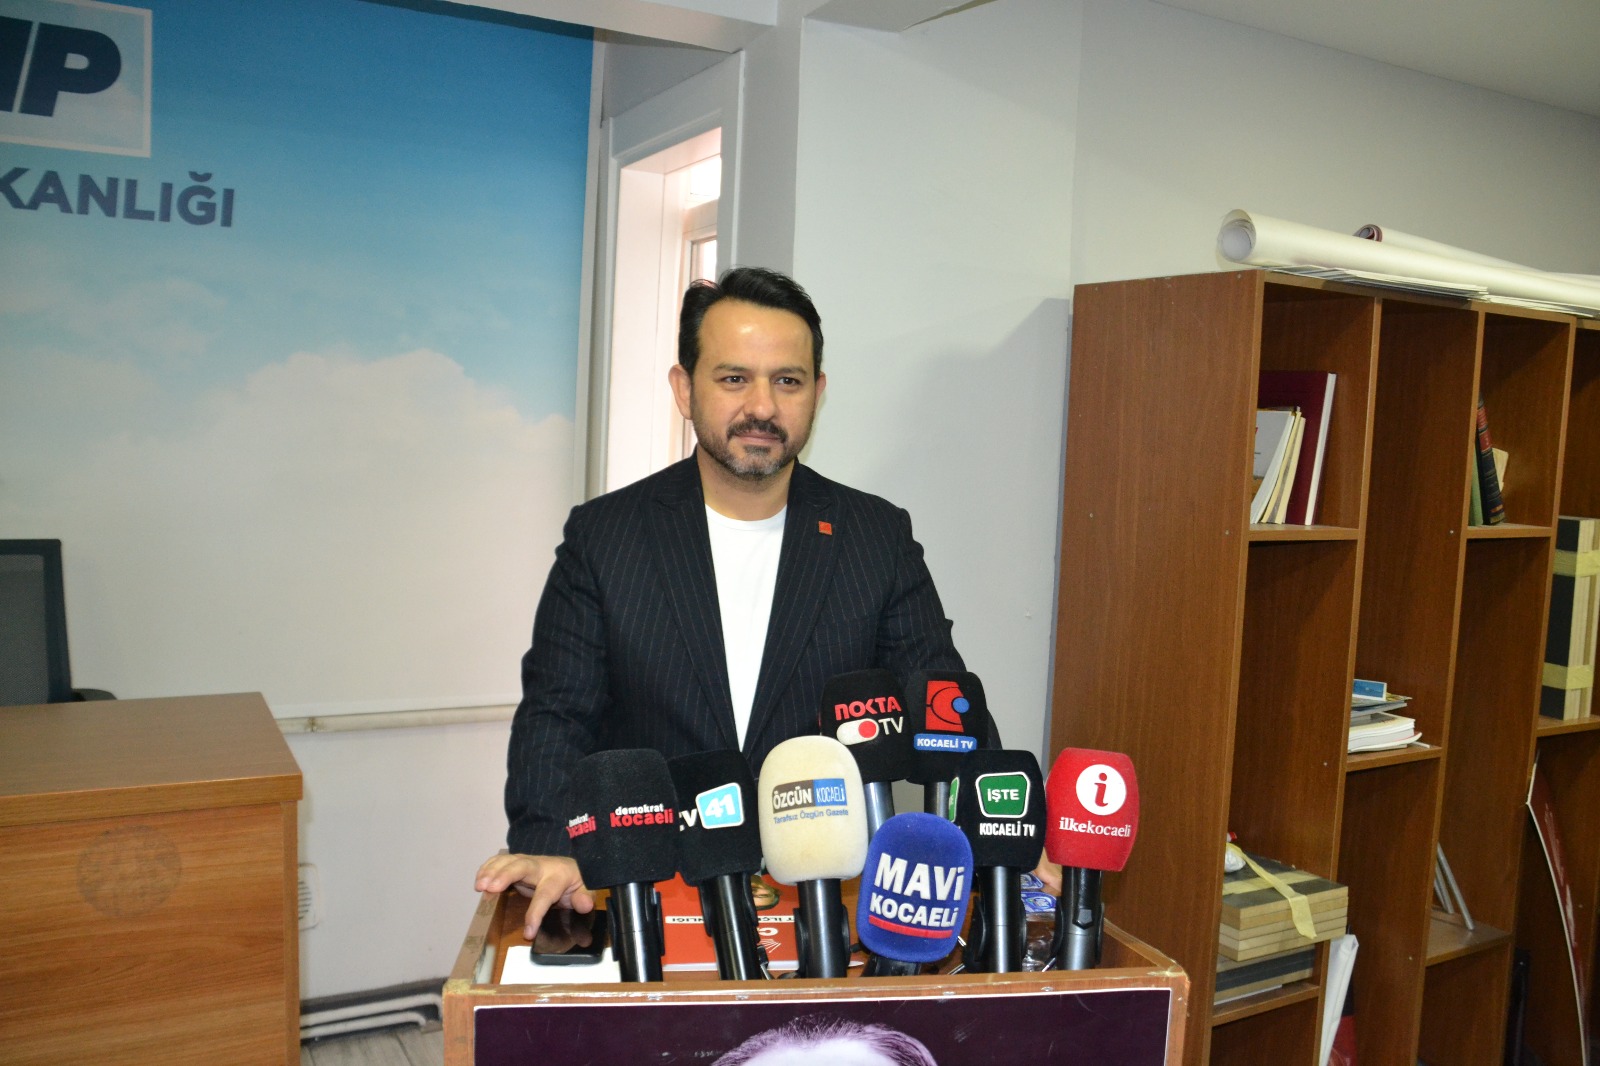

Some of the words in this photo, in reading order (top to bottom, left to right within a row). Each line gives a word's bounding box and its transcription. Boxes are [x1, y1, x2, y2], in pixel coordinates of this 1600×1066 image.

[878, 716, 904, 735] TV
[917, 738, 959, 749] KOCAELİ
[960, 740, 974, 749] TV
[773, 786, 813, 810] ÖZGÜN
[816, 784, 846, 803] KOCAELİ
[987, 788, 1020, 803] İŞTE
[614, 803, 664, 816] demokrat
[705, 793, 736, 818] 41
[800, 810, 825, 820] Özgün
[826, 808, 849, 816] Gazete
[609, 808, 675, 828] kocaeli
[1059, 816, 1132, 837] ilkekocaeli
[979, 821, 1022, 836] KOCAELİ
[1023, 824, 1036, 837] TV
